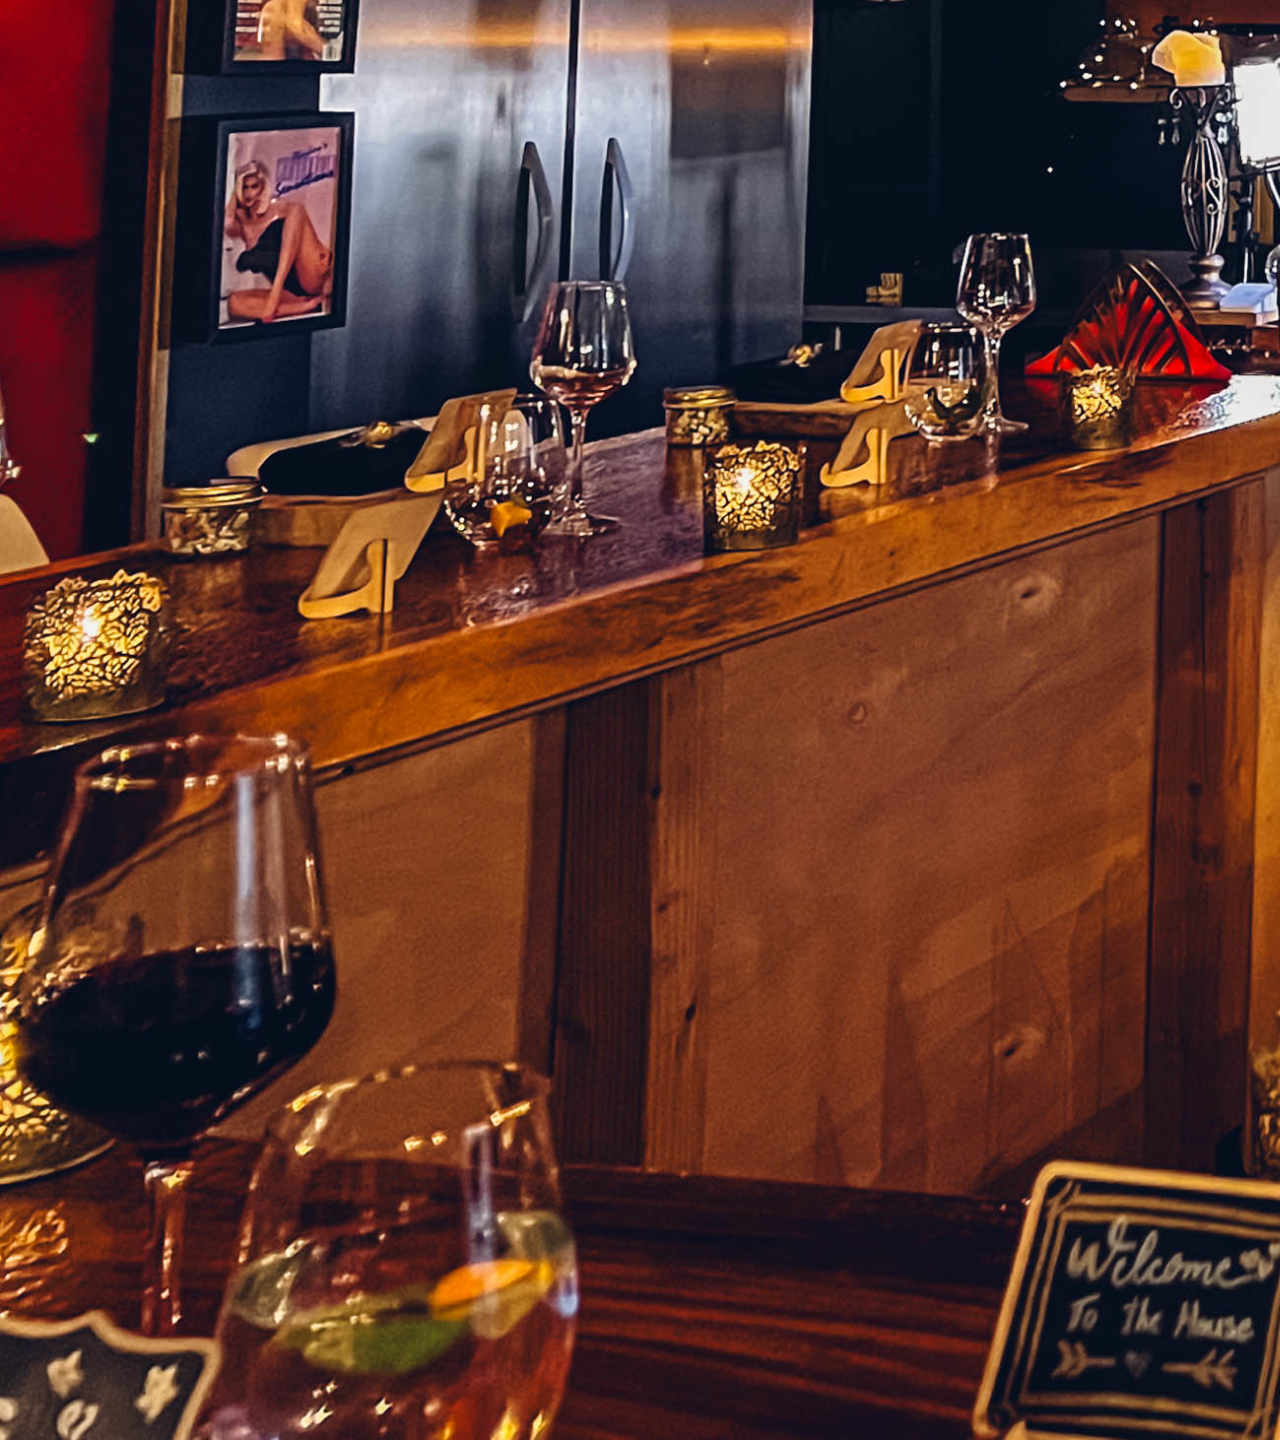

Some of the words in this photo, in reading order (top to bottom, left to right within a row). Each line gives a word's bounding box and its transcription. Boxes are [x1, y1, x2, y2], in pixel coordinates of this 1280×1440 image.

[1066, 1216, 1250, 1288] Welcome
[1067, 1294, 1100, 1332] To
[1174, 1300, 1254, 1343] House
